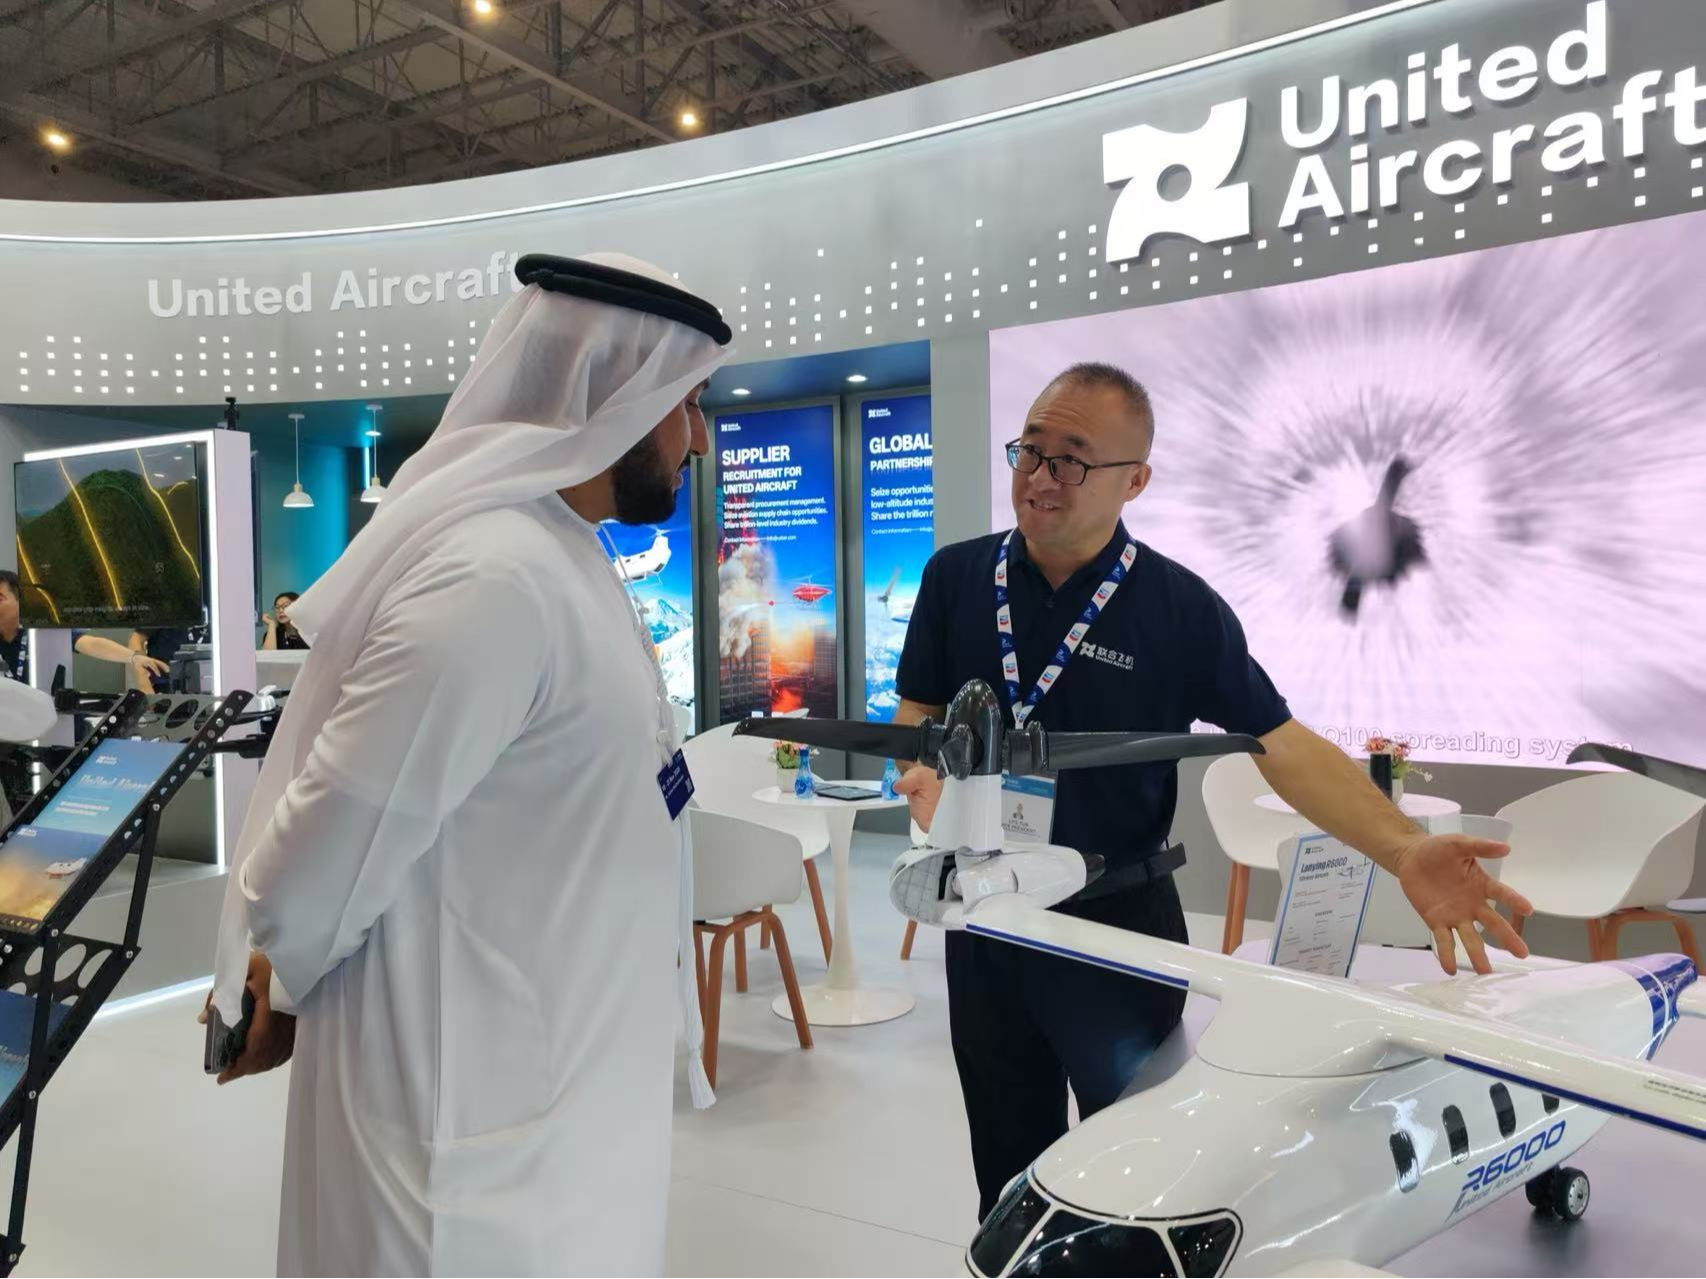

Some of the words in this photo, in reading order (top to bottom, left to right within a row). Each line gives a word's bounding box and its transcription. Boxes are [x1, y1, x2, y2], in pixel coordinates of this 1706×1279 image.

[1280, 0, 1608, 149] United
[1277, 65, 1706, 229] Aircraft
[148, 271, 312, 318] United
[330, 251, 526, 311] Aircraft
[869, 432, 933, 454] GLOBAL
[722, 445, 790, 466] SUPPLIER
[723, 467, 783, 482] RECRUITMENT
[784, 466, 802, 477] FOR
[723, 483, 754, 495] UNITED
[755, 480, 798, 492] AIRCRAFT
[870, 487, 890, 497] Seize
[723, 502, 755, 510] Transparent
[755, 500, 789, 509] procurement
[871, 498, 913, 509] low-altitude
[759, 508, 777, 518] supply
[871, 511, 892, 521] Share
[893, 510, 906, 520] the
[906, 509, 929, 519] trillion
[770, 519, 791, 528] industry
[1390, 730, 1522, 760] spreading
[1459, 1119, 1566, 1194] R6000
